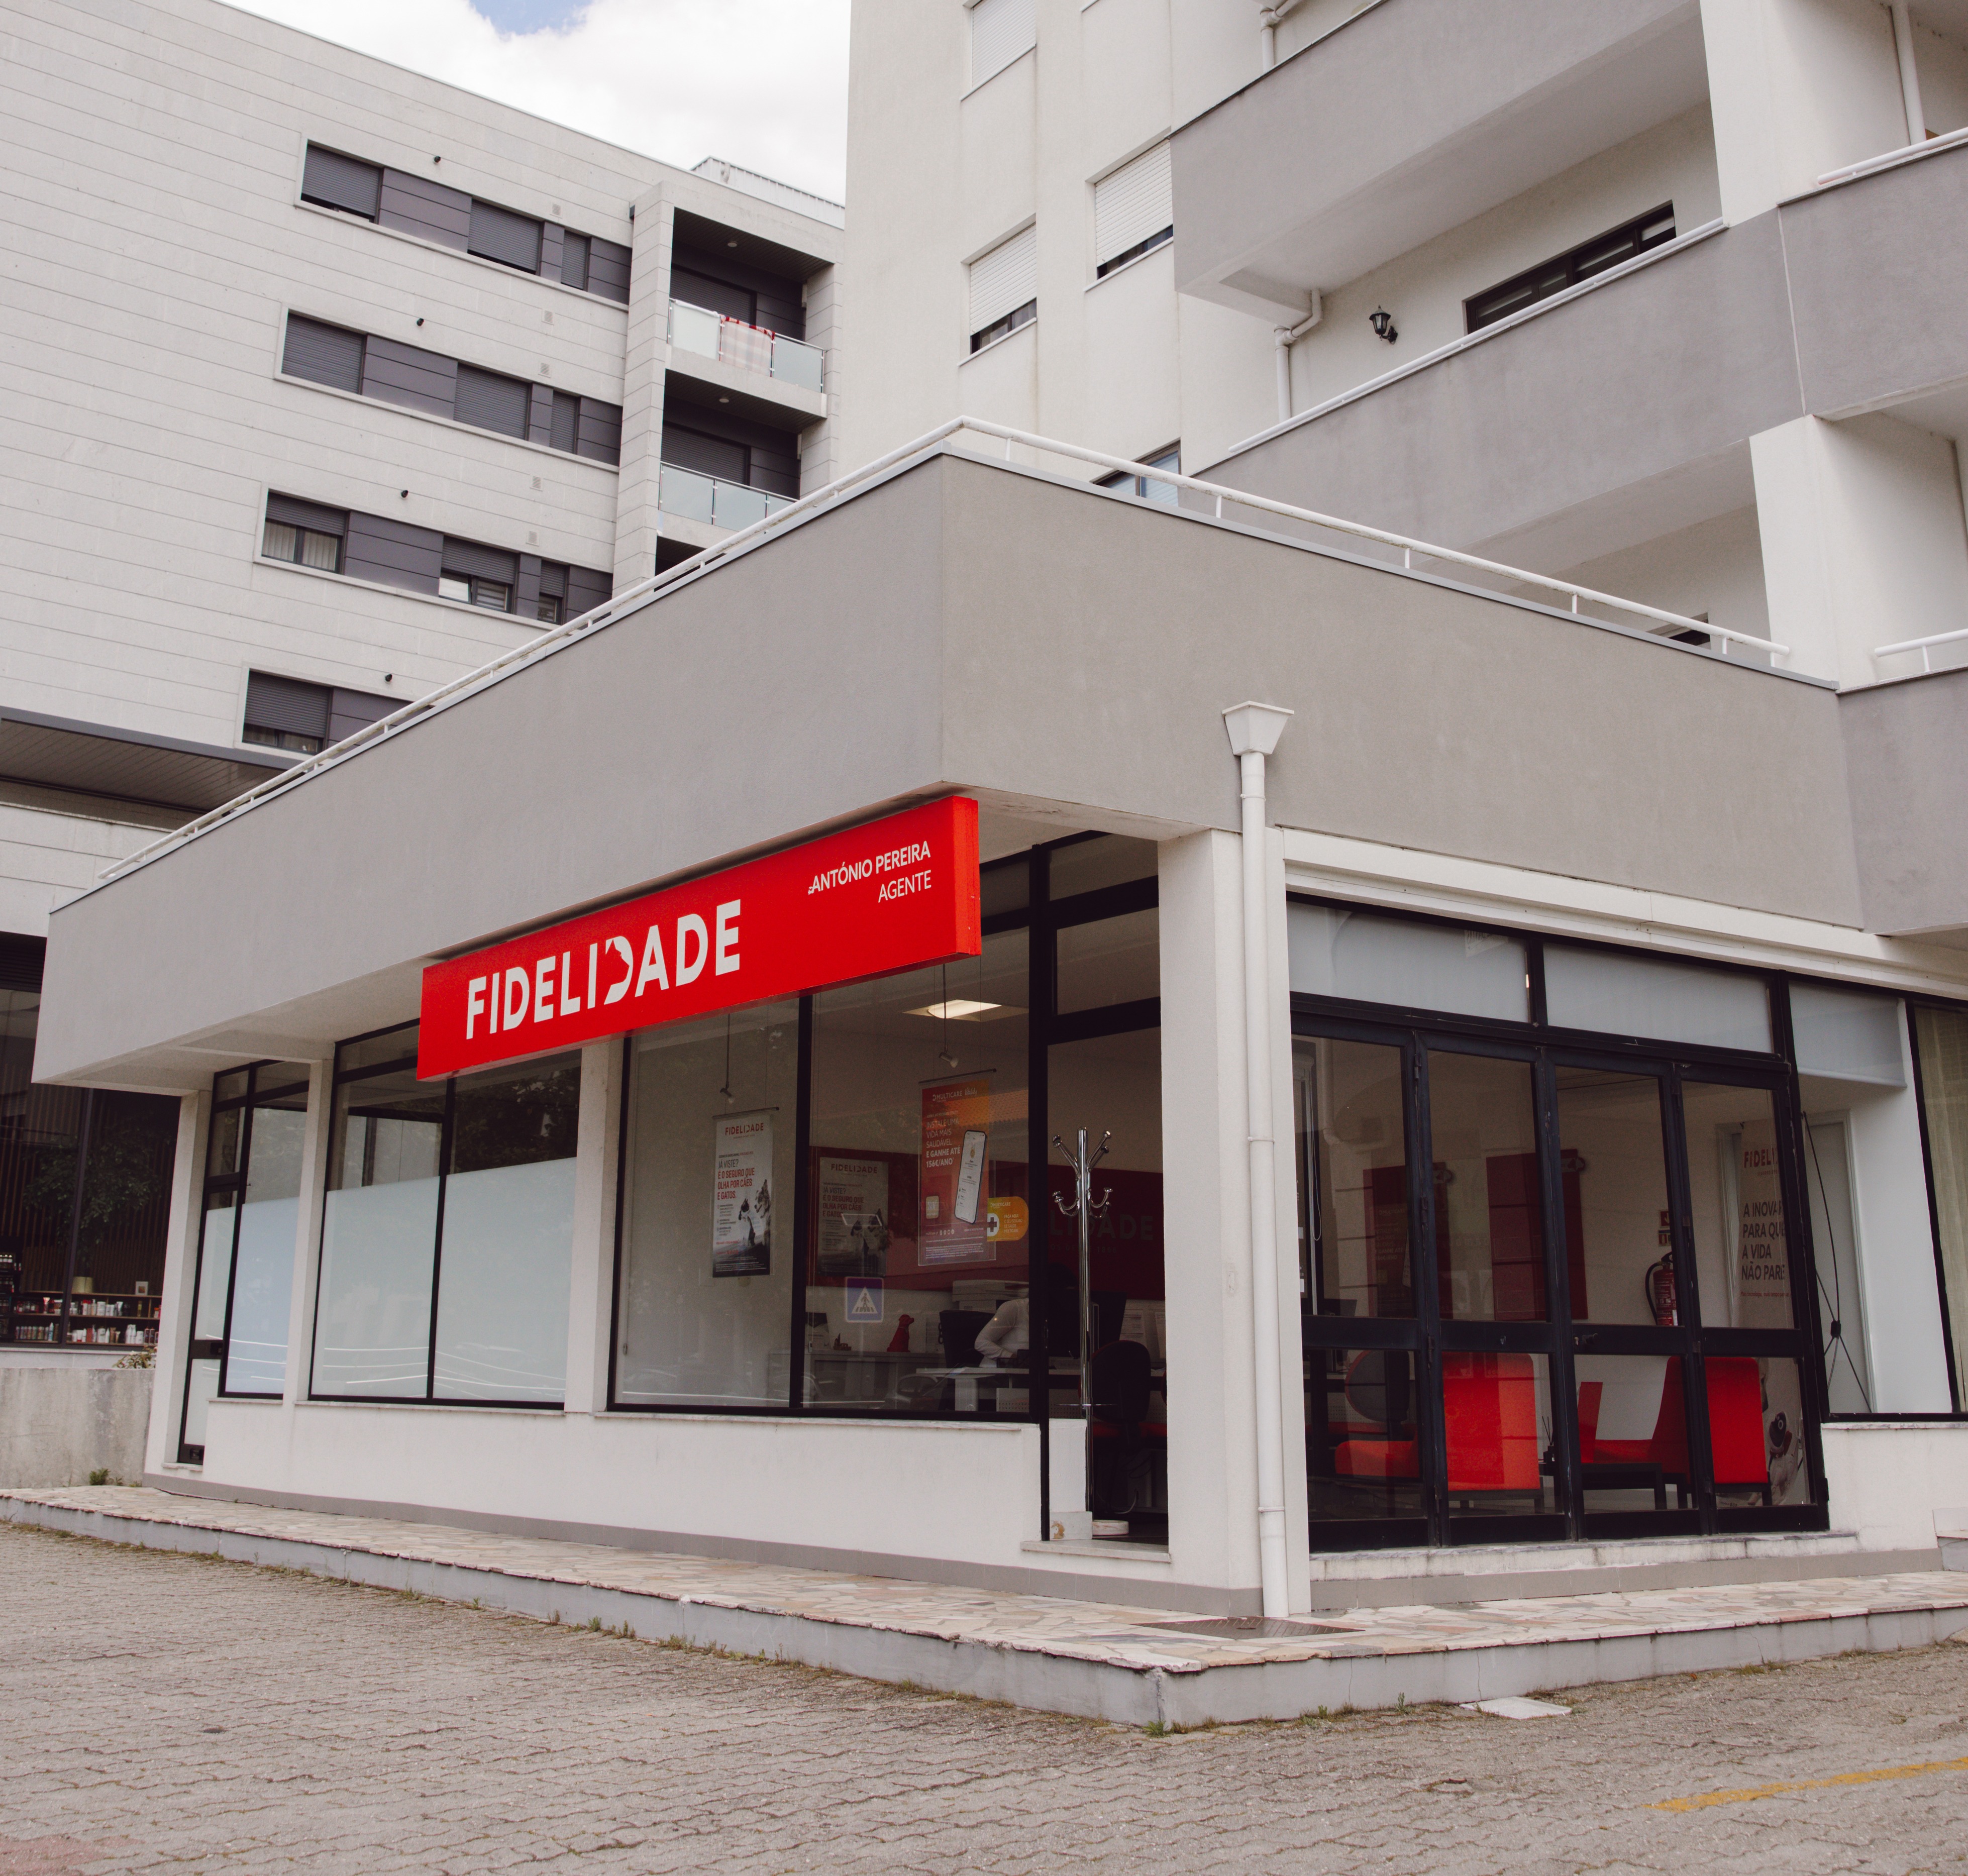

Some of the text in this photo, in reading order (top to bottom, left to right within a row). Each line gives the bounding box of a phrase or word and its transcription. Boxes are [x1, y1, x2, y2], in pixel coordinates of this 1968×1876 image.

[808, 841, 930, 895] ANTÓNIO PEREIRA
[878, 870, 931, 903] AGENTE
[466, 899, 741, 1039] FIDELIDADE
[725, 1123, 764, 1135] FIDELIDADE
[926, 1117, 959, 1128] INSTALE UMA
[926, 1128, 952, 1138] VIDA MAIS
[926, 1137, 952, 1149] SAUDÁVEL
[930, 1149, 949, 1158] GANHE
[950, 1145, 961, 1155] ATÉ
[1744, 1147, 1778, 1168] FIDELI
[718, 1159, 739, 1169] JÁ VISTE?
[831, 1164, 878, 1174] FIDELIDADE
[718, 1168, 755, 1179] É O SEGURO QUE
[717, 1177, 753, 1190] OLHA POR CÃES
[721, 1191, 737, 1200] GATOS.
[849, 1203, 862, 1211] CÃES
[1743, 1203, 1749, 1217] A
[1743, 1223, 1767, 1238] PARA
[1742, 1243, 1772, 1260] A VIDA
[1741, 1261, 1785, 1280] NÃO PARE
